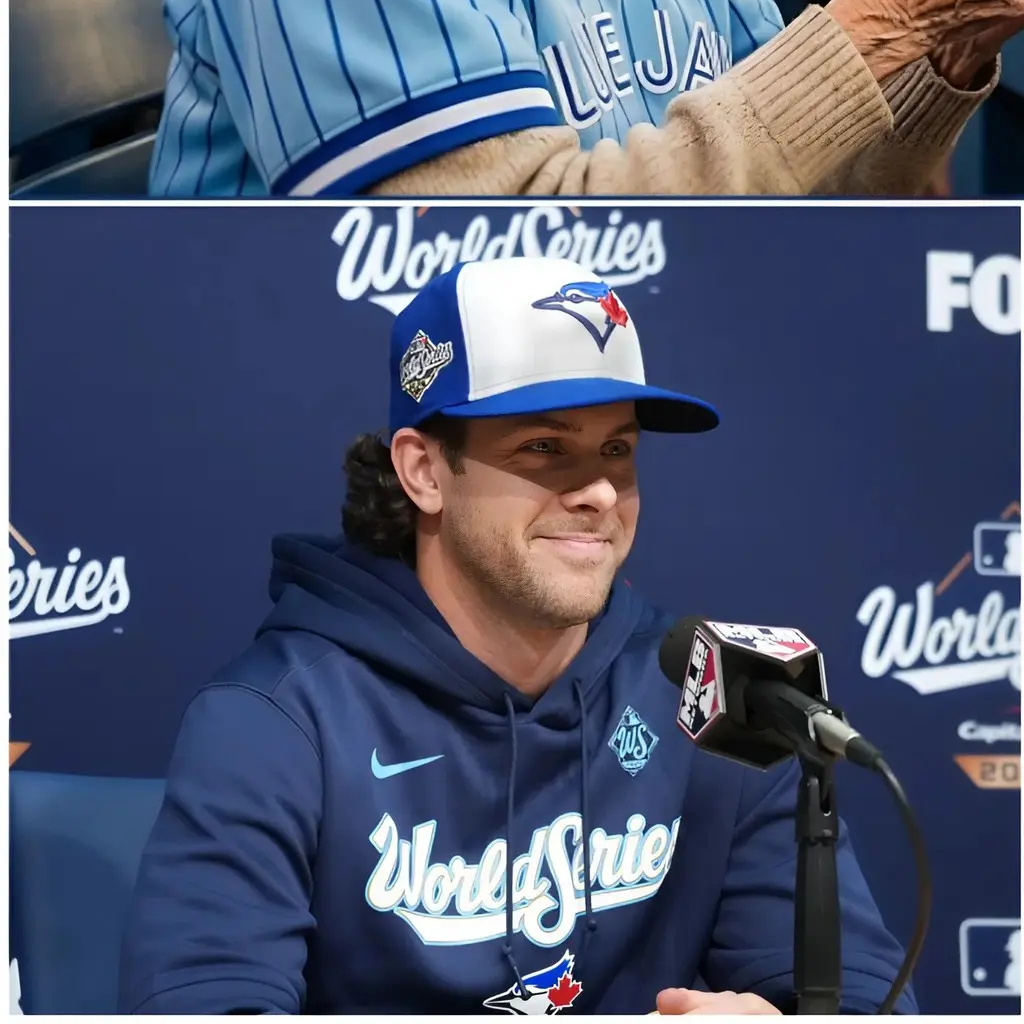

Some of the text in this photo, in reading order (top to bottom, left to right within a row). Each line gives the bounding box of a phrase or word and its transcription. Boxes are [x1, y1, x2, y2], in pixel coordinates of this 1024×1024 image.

[542, 9, 733, 130] LUE JA
[926, 250, 1020, 335] FO
[9, 547, 130, 626] eries
[617, 724, 648, 760] WS
[980, 761, 1019, 782] 20
[521, 812, 682, 947] Serie
